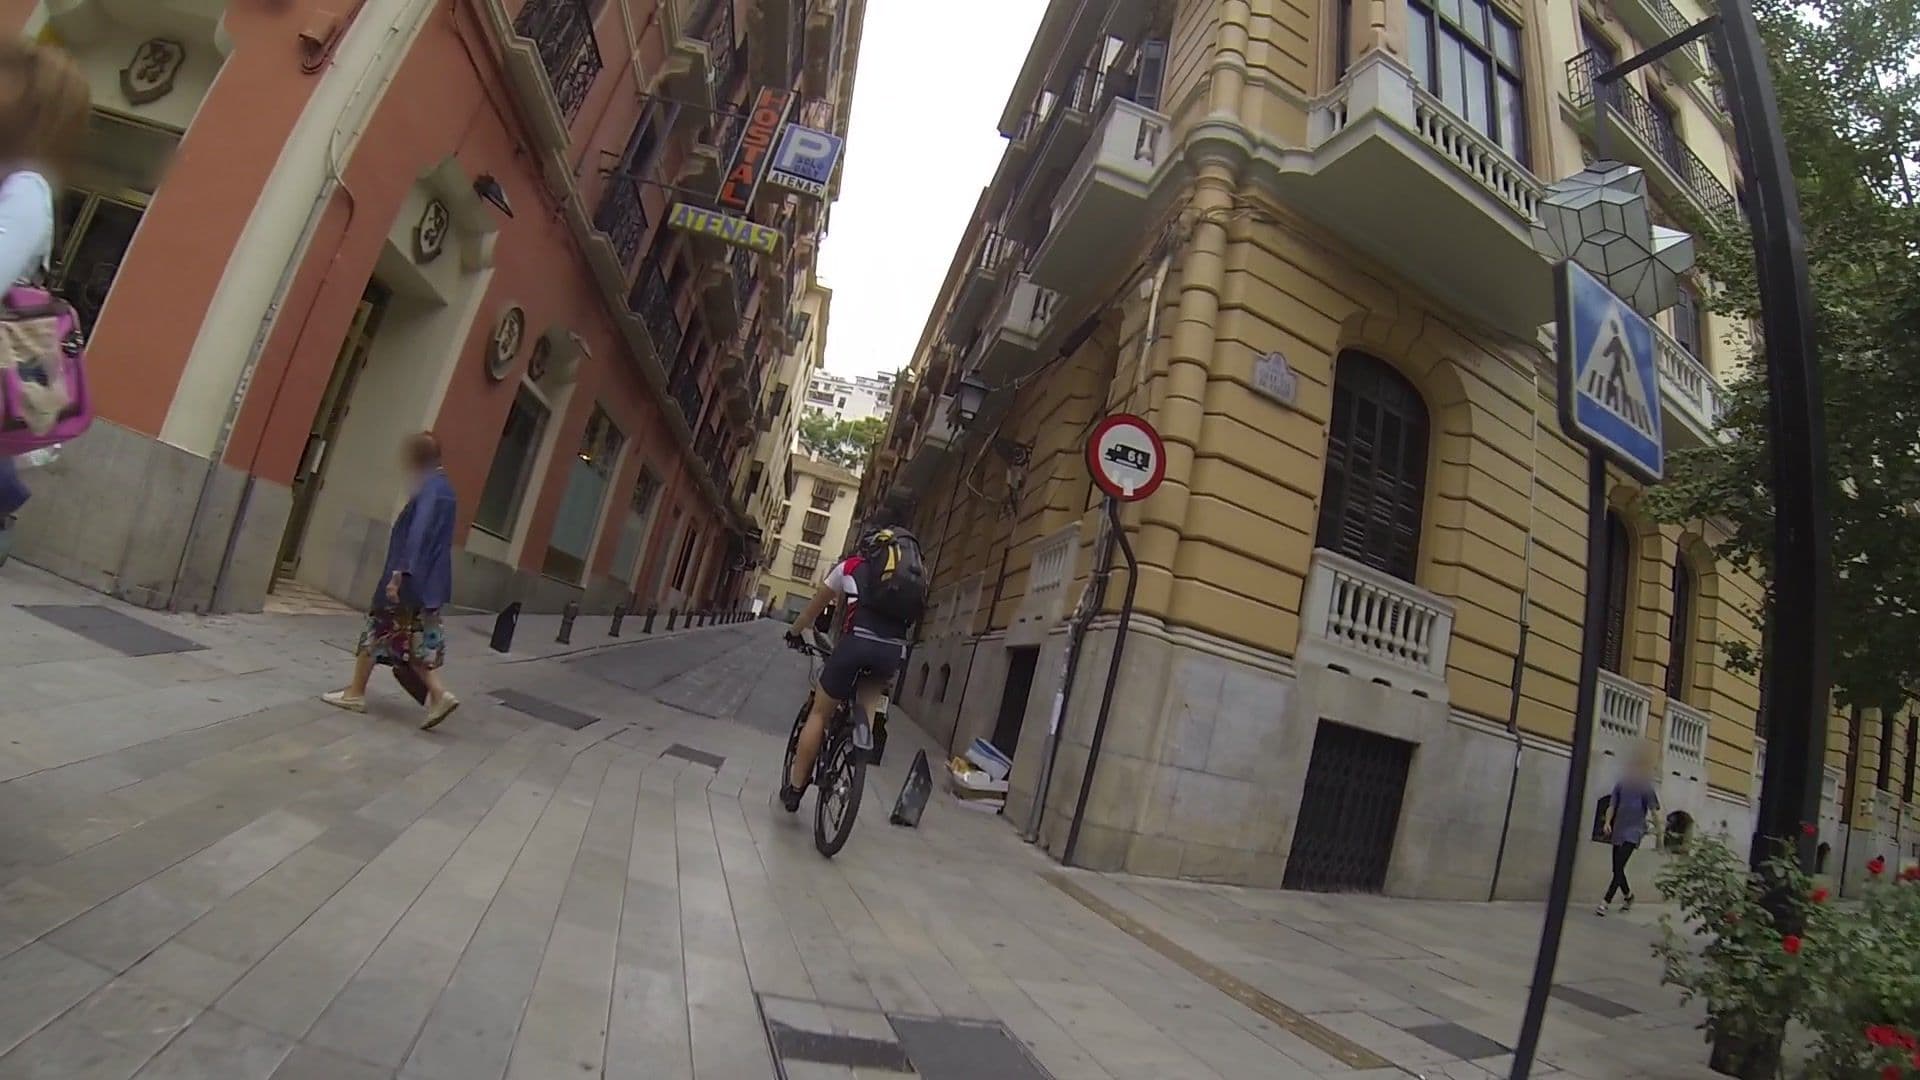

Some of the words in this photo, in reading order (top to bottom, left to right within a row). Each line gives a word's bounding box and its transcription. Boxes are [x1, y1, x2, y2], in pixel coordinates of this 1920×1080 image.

[721, 88, 788, 207] HOSTAL
[782, 128, 832, 170] P
[772, 173, 822, 195] ATENAS
[674, 206, 772, 248] ATENAS
[1127, 450, 1144, 465] 6t
